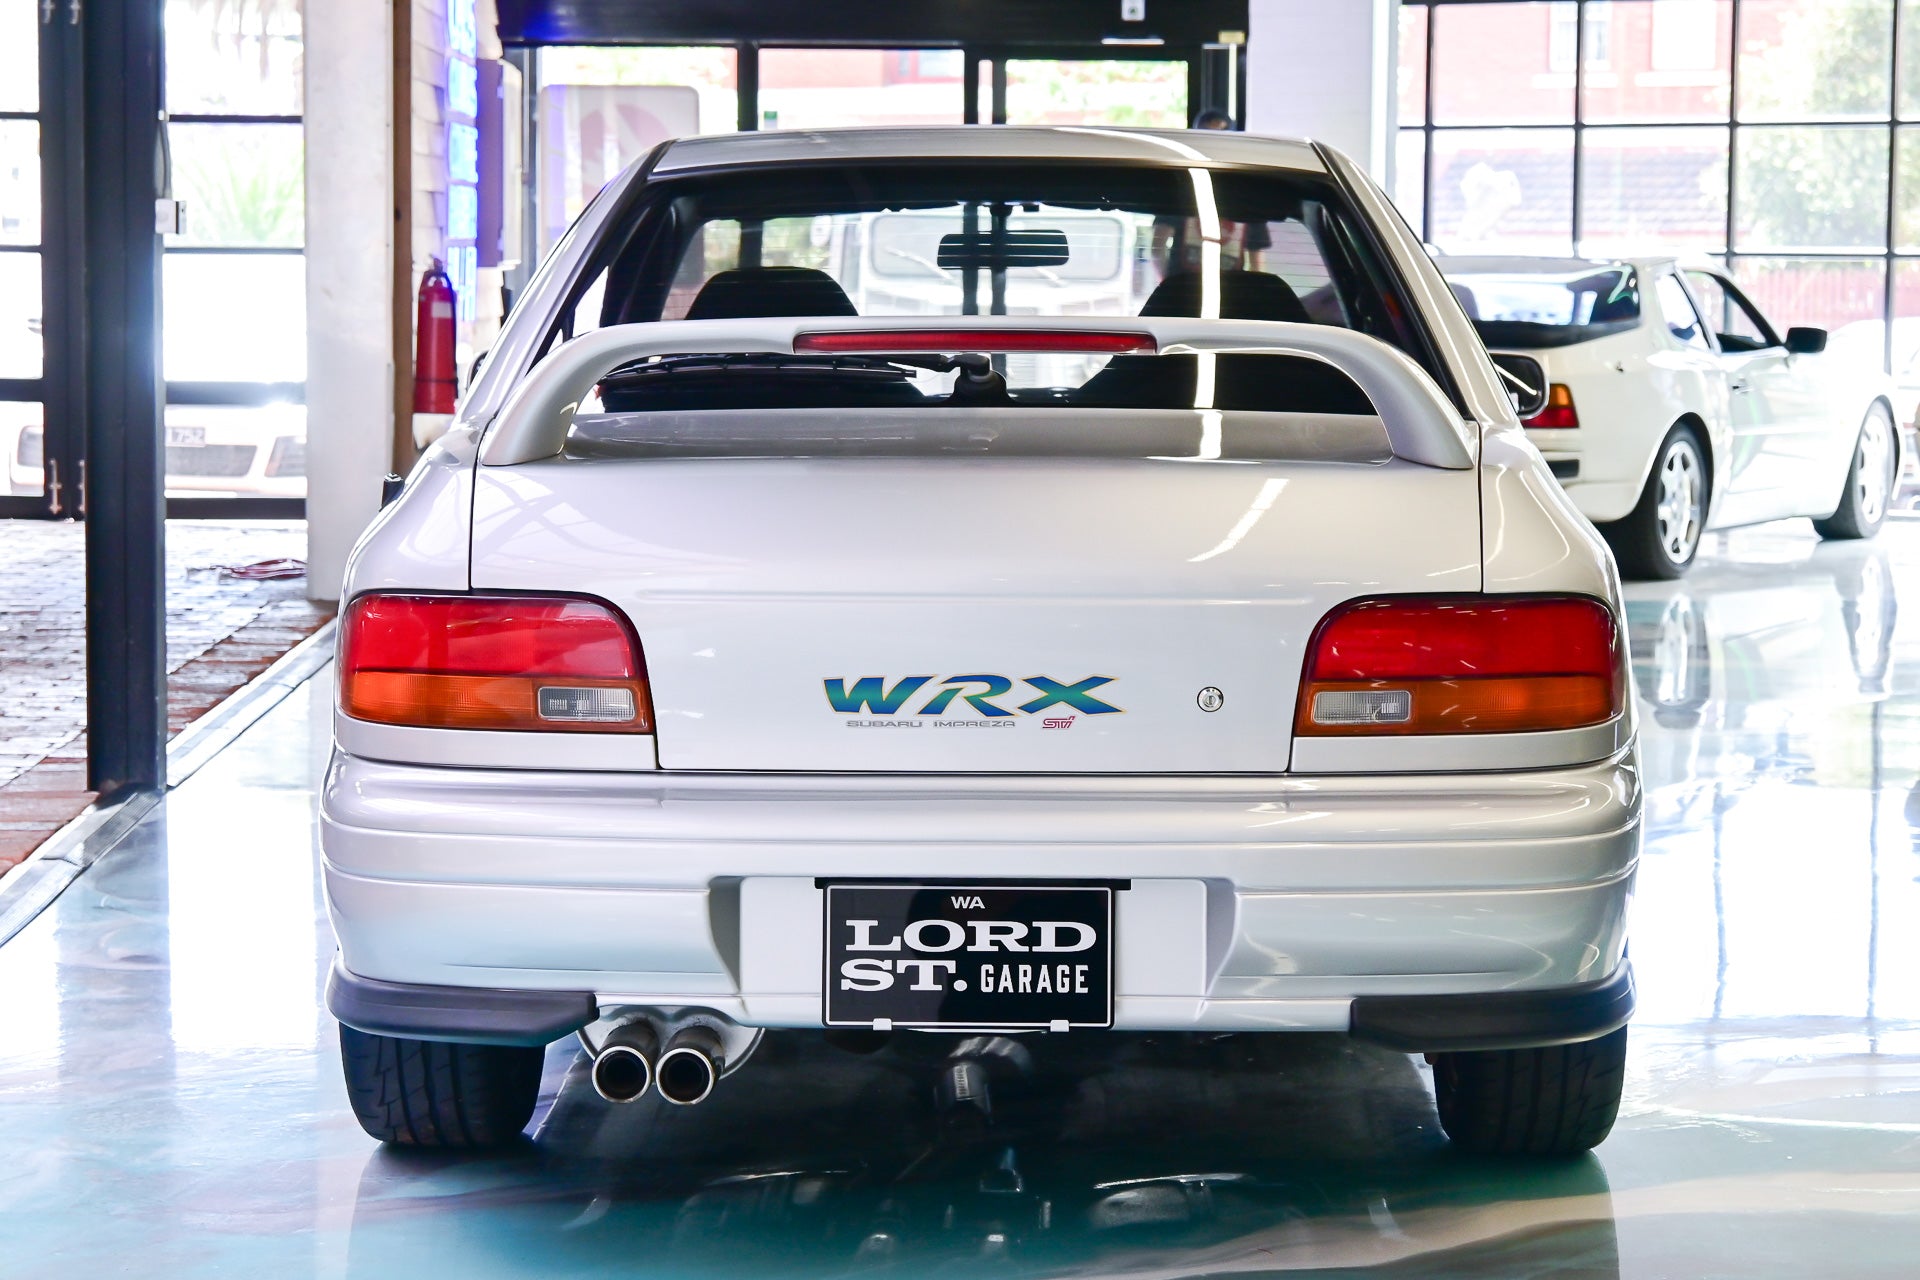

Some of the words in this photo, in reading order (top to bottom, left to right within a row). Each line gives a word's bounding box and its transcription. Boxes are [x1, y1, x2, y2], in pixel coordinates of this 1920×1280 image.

[822, 673, 1125, 717] WRX
[846, 720, 923, 728] SUBARU
[933, 720, 1016, 728] IMPREZA
[950, 896, 985, 909] WA
[845, 919, 1097, 952] LORD
[840, 958, 968, 992] ST.
[980, 964, 1089, 993] GARAGE
